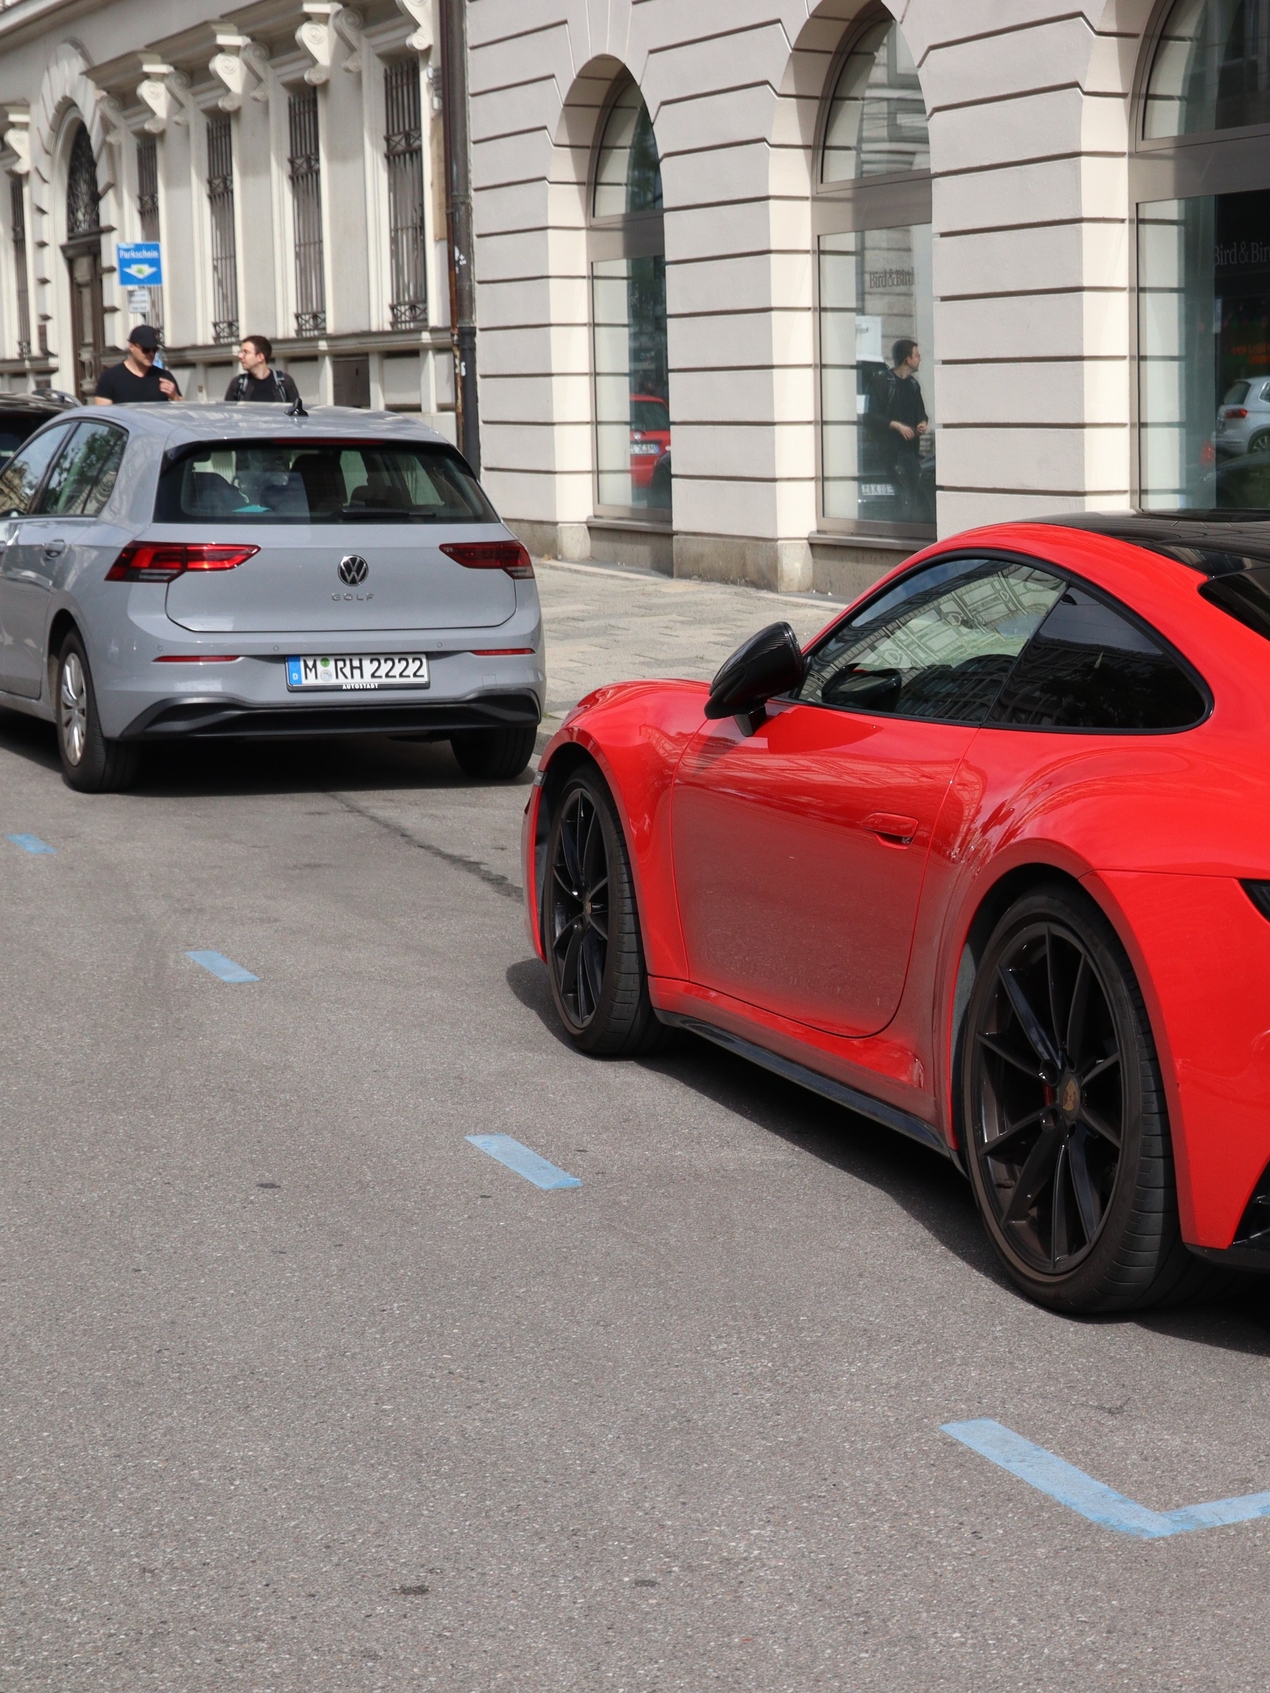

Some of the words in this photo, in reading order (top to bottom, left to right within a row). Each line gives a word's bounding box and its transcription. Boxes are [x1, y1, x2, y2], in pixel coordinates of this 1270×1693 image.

[332, 593, 374, 601] GOLF
[303, 658, 319, 680] M
[333, 657, 364, 680] RH
[370, 657, 425, 679] 2222
